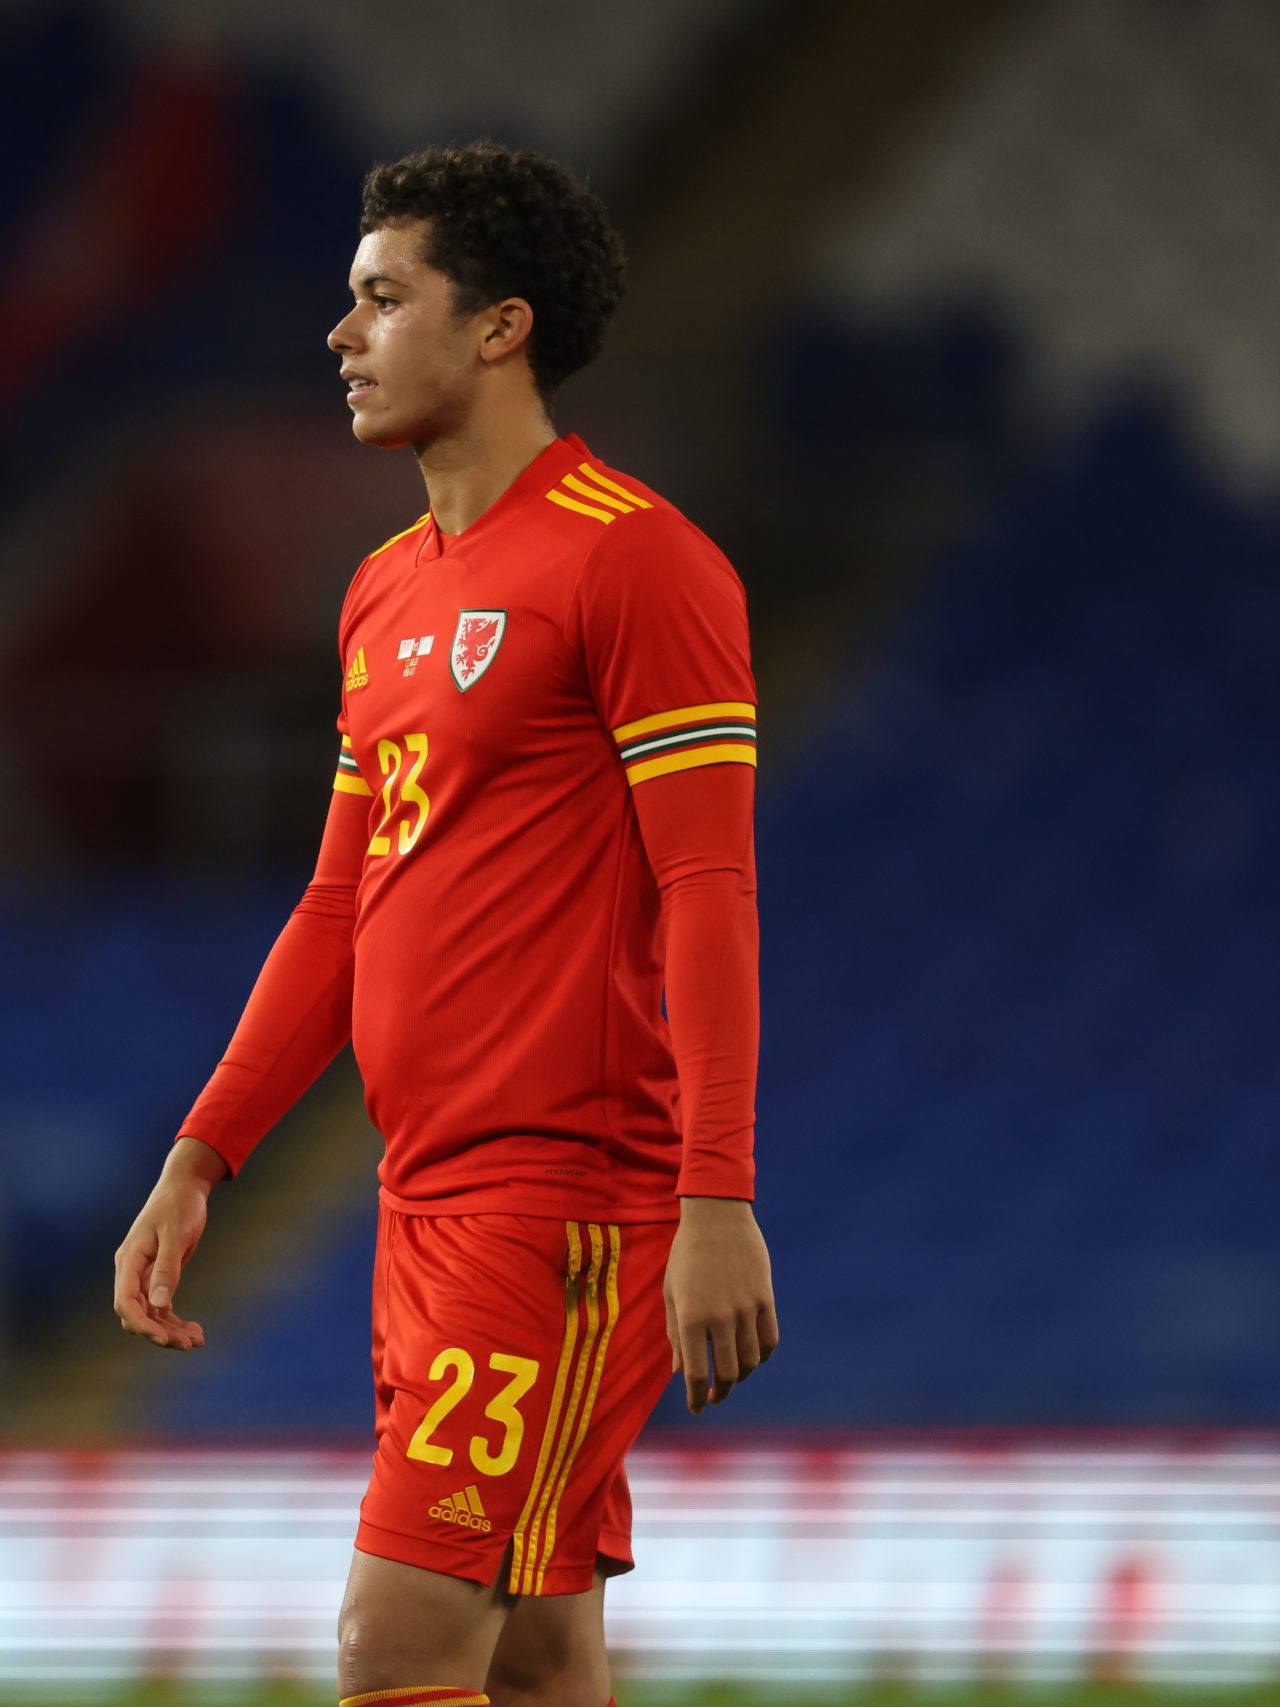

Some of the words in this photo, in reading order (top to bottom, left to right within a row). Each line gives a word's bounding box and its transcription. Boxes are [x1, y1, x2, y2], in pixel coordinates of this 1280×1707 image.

[368, 734, 430, 855] 23
[407, 1347, 540, 1476] 23
[428, 1505, 491, 1532] adidas
